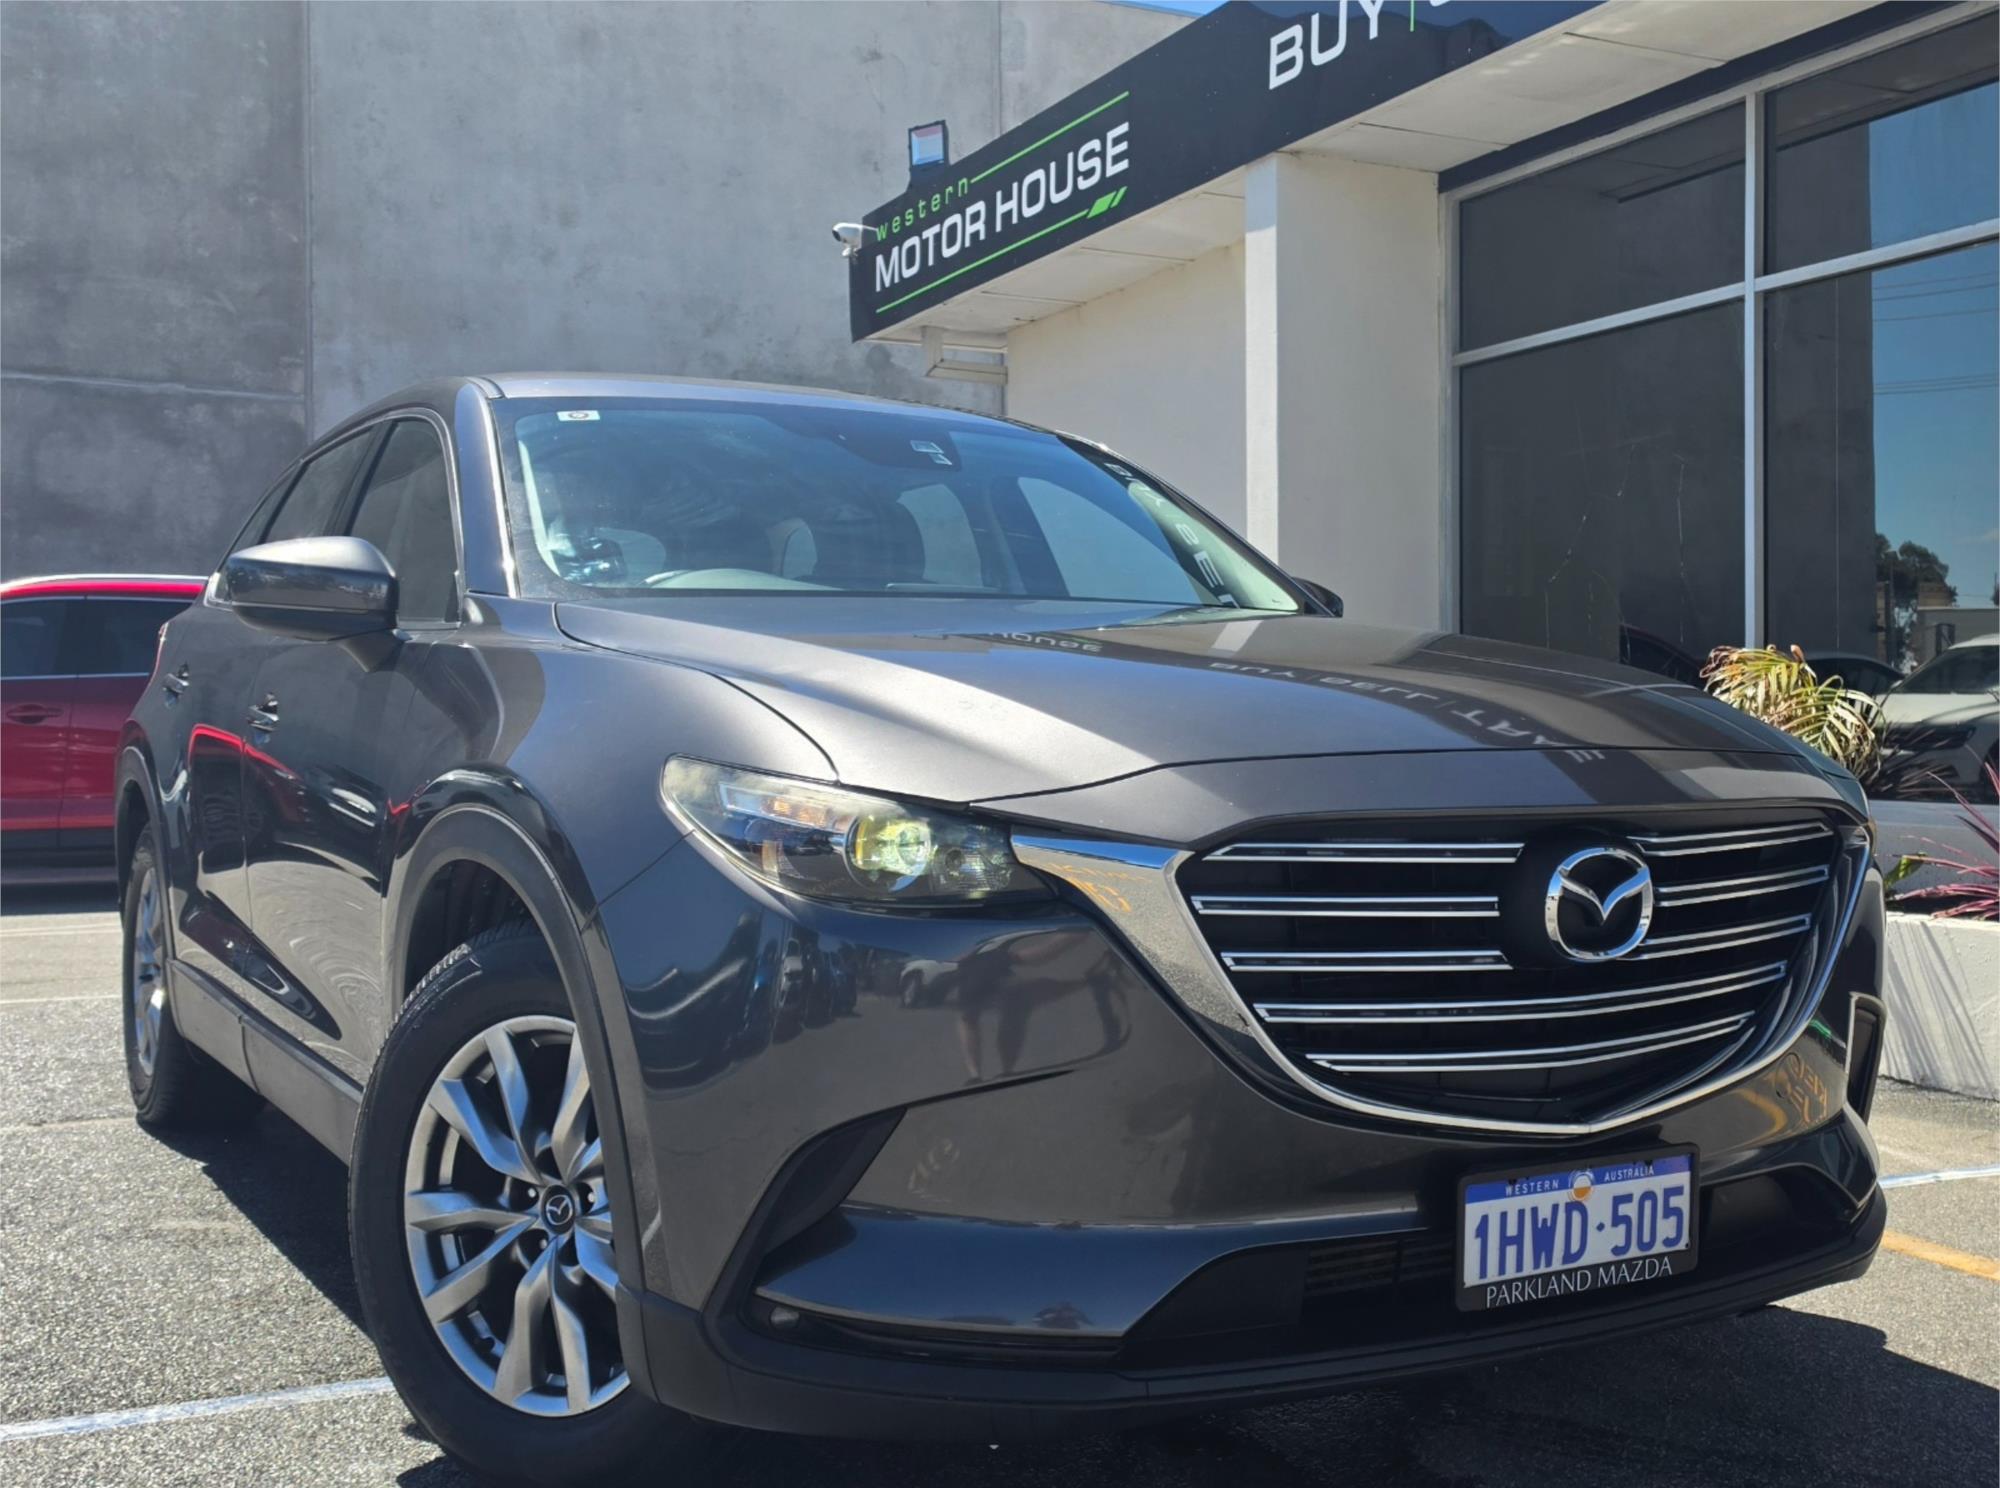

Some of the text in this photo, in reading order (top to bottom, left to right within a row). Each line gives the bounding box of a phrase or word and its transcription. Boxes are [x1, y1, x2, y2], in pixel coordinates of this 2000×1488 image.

[1269, 0, 1384, 90] BUY
[876, 122, 1129, 292] MOTOR HOUSE
[876, 177, 968, 241] western
[1505, 1165, 1655, 1196] WESTERN AUSTRALIA
[1486, 1256, 1673, 1308] PARKLAND MAZDA
